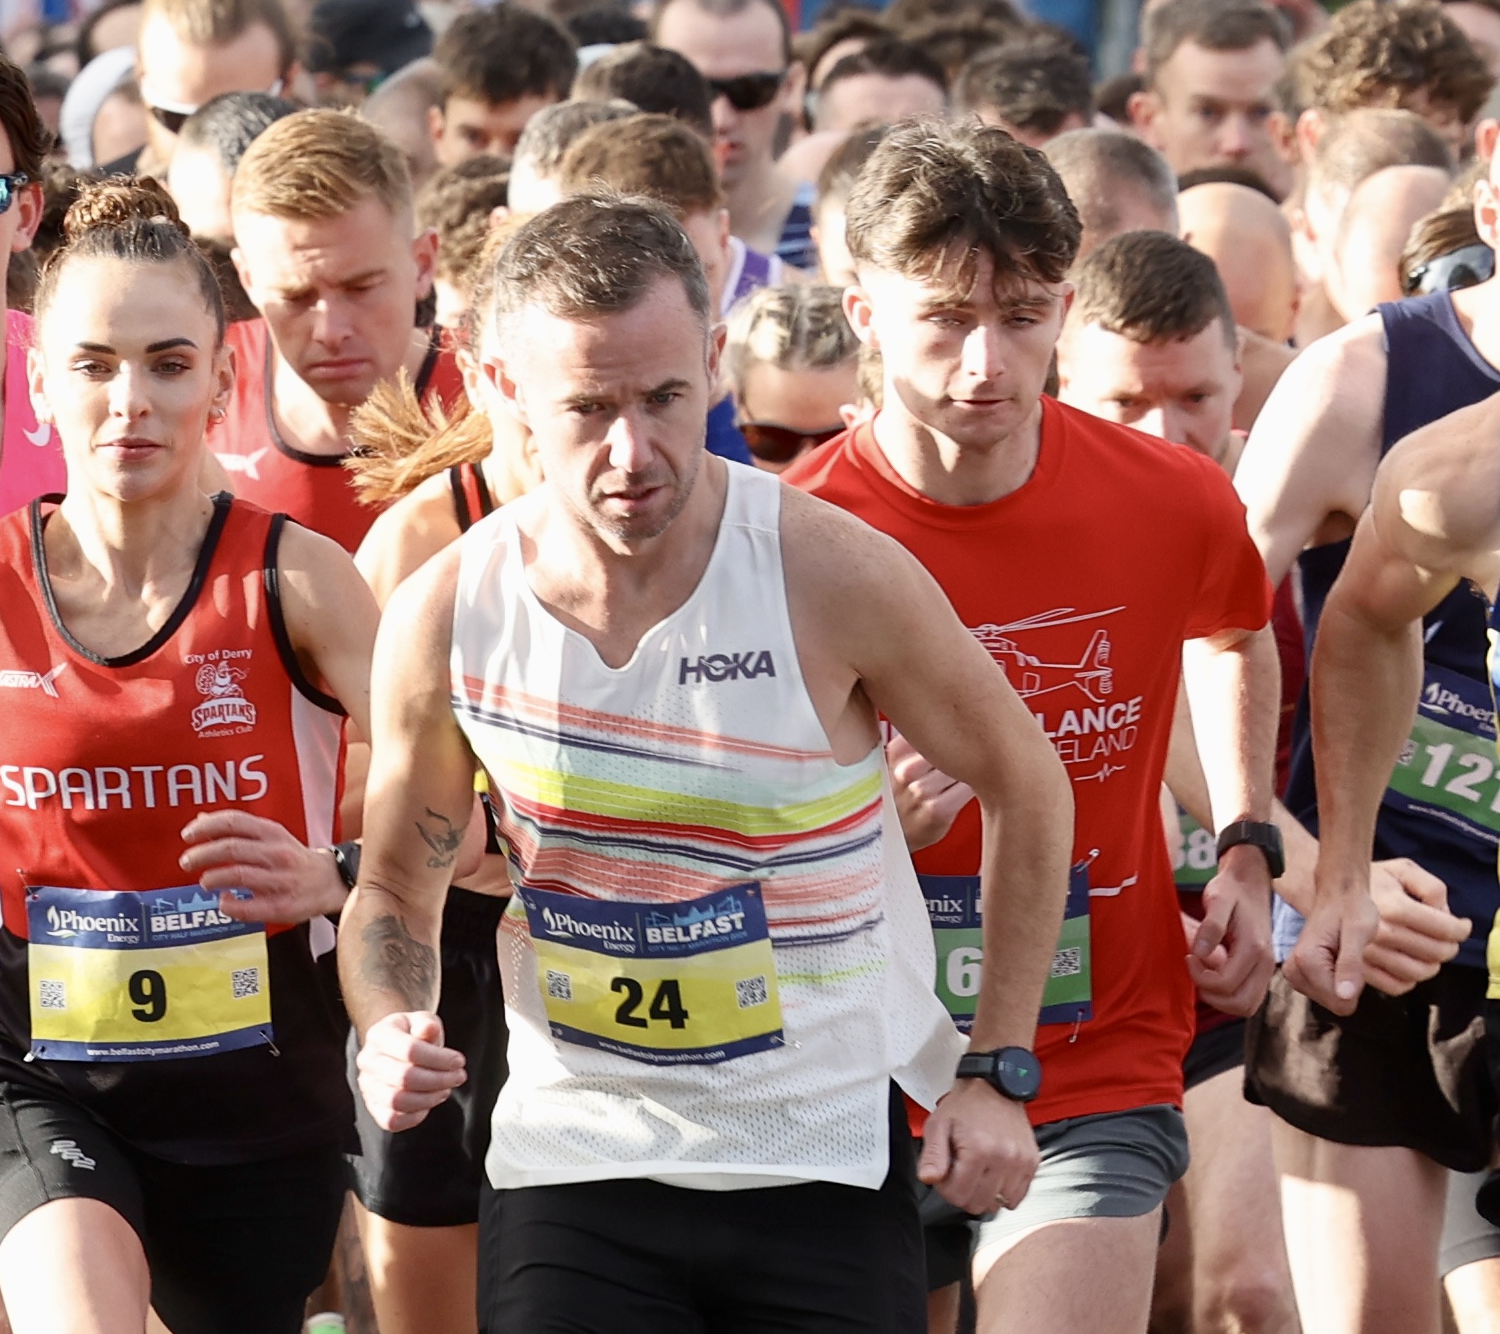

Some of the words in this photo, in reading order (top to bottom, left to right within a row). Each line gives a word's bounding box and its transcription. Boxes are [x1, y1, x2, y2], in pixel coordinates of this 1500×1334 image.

[184, 653, 205, 665] City
[207, 651, 221, 660] of
[222, 648, 253, 662] Derry
[678, 650, 777, 686] HOKA
[193, 703, 255, 727] SPARTANS
[1438, 688, 1497, 724] Phoen
[236, 726, 254, 735] Club
[0, 754, 269, 811] SPARTANS
[61, 909, 139, 933] Phoenix
[151, 909, 240, 933] BELFAS
[553, 914, 635, 943] Phoenix
[645, 912, 745, 944] BELFAST
[107, 932, 140, 944] Energy
[152, 933, 170, 941] CITY
[603, 940, 637, 954] Energy
[128, 969, 167, 1023] 9
[610, 976, 690, 1029] 24
[86, 1040, 220, 1057] www.belfastcitymarathon.com
